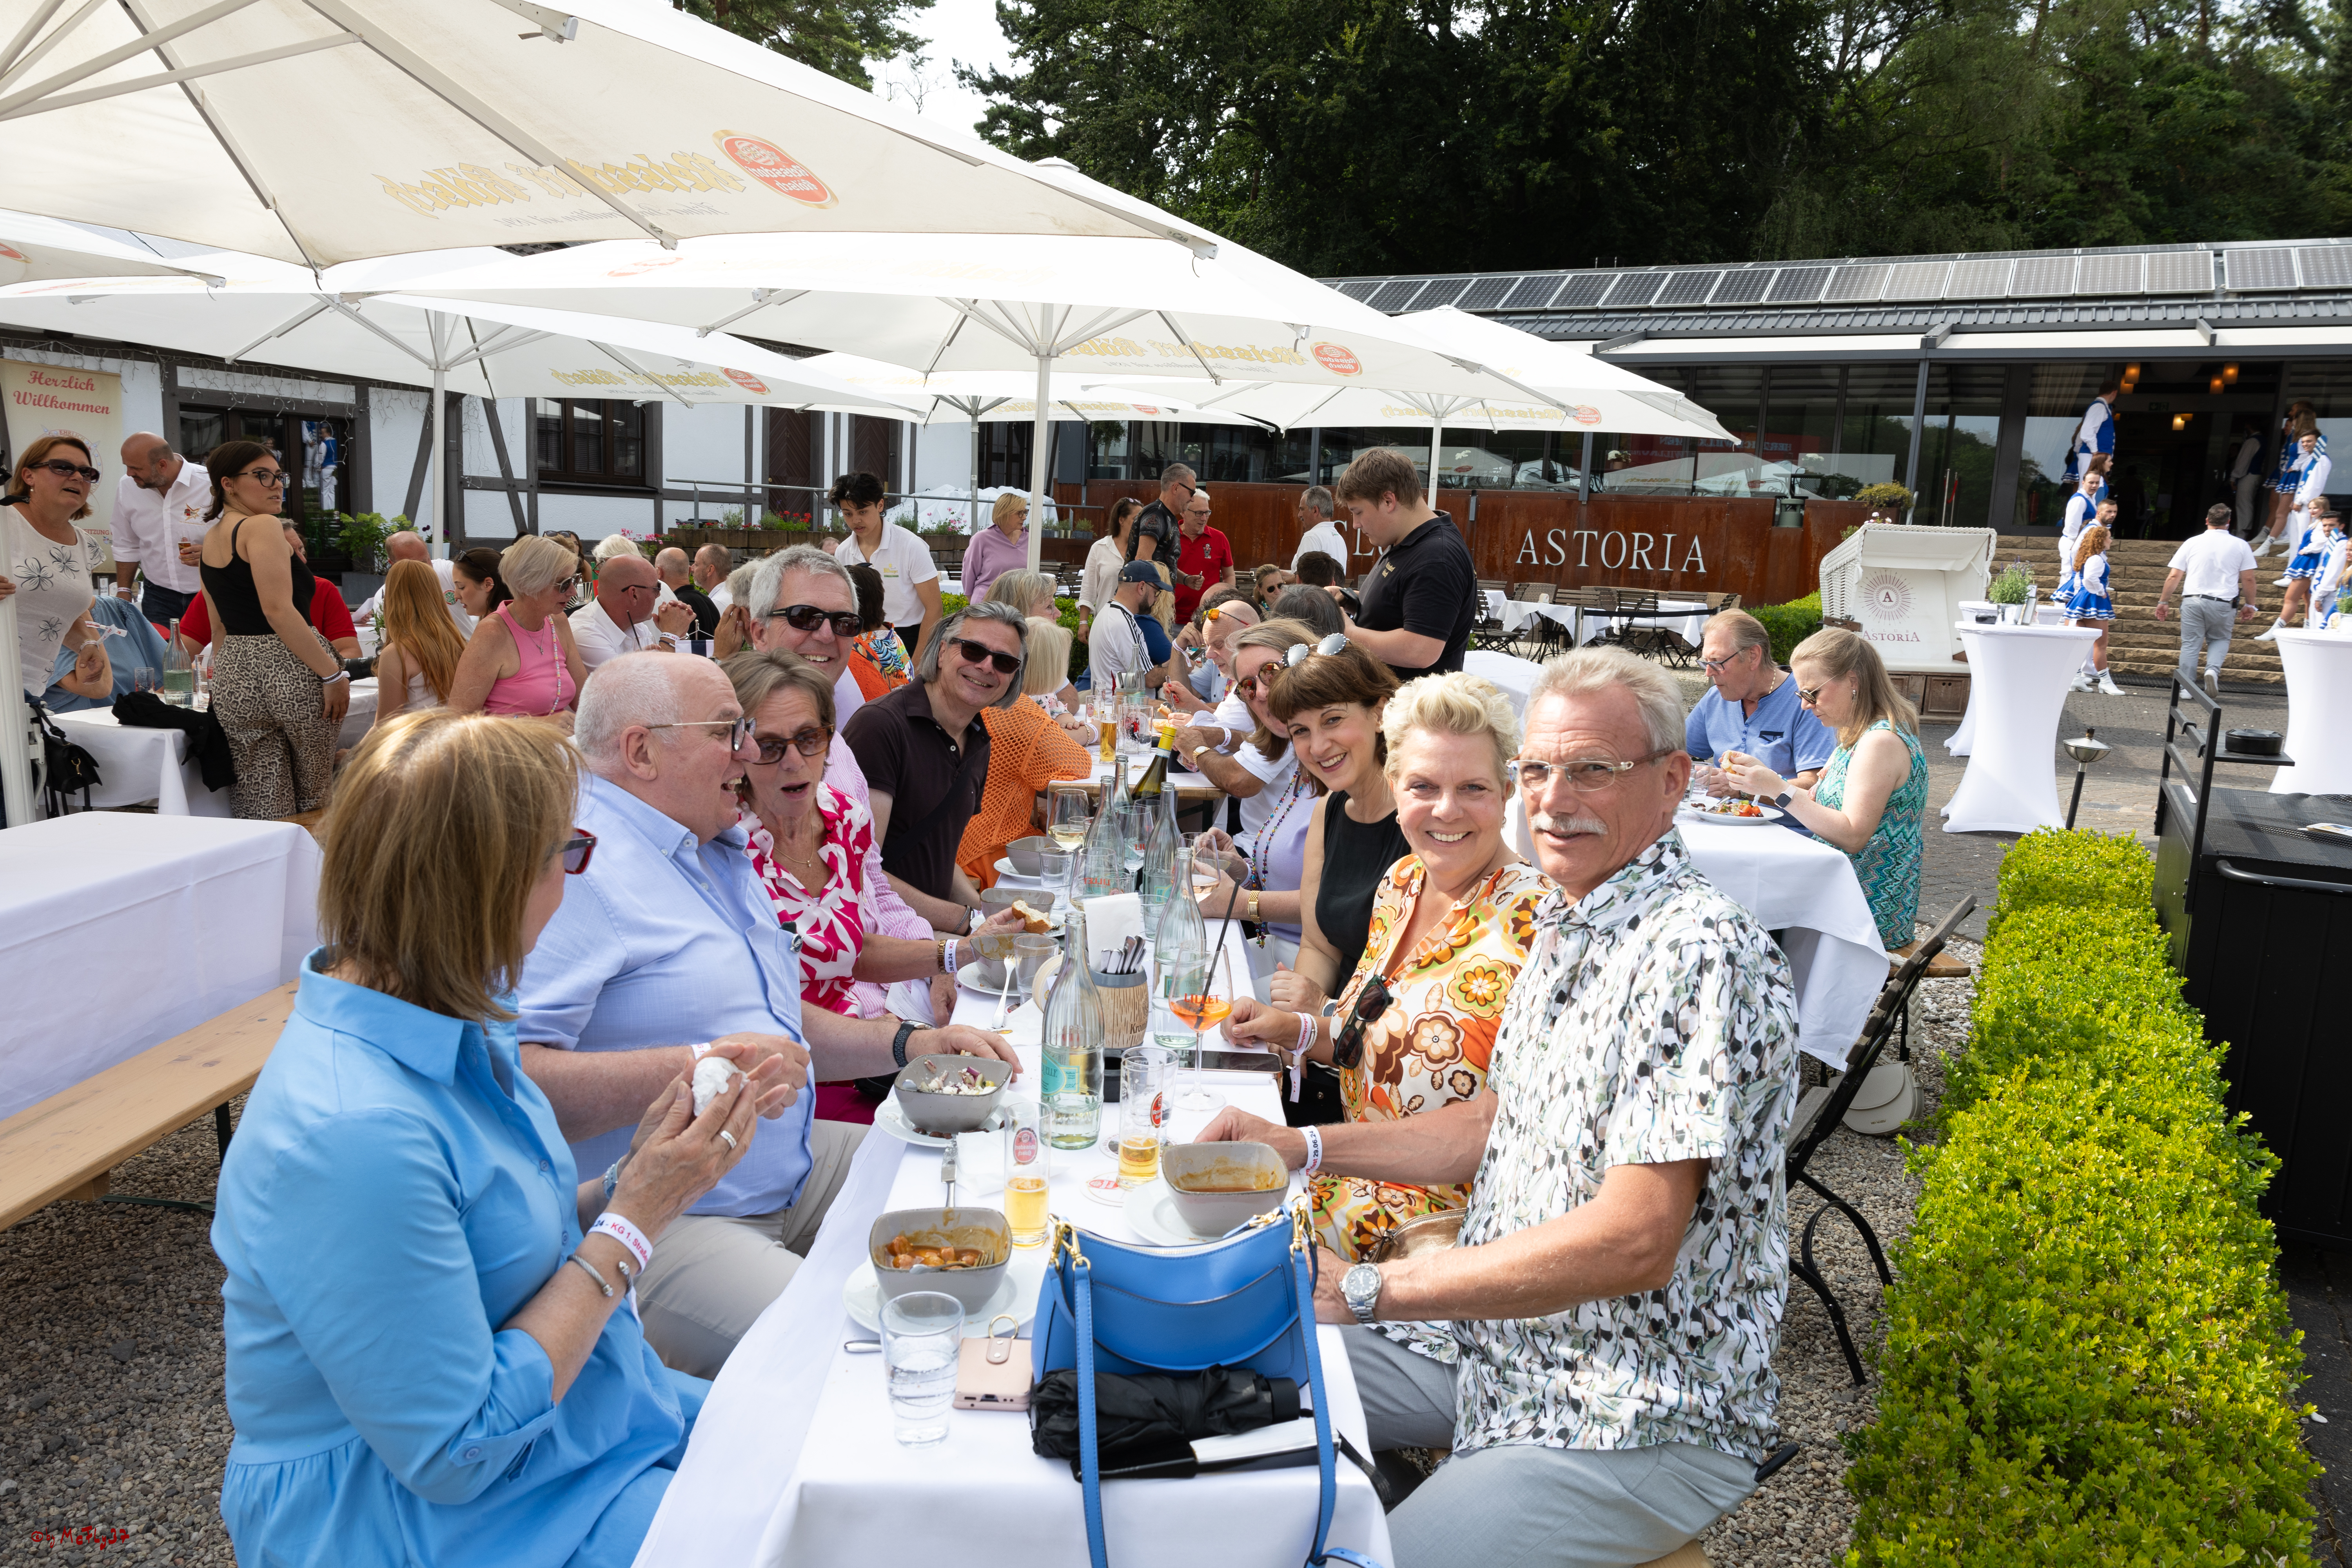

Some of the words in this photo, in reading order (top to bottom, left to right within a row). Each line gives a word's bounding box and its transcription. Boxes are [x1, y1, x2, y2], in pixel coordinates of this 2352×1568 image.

[27, 370, 95, 391] Herzlich
[13, 390, 110, 415] Willkommen
[1515, 528, 1707, 573] ASTORIA
[1882, 591, 1893, 602] A
[1863, 630, 1921, 642] ASTORIA
[1183, 993, 1220, 1004] LILLET
[1308, 1131, 1318, 1157] 29.06.24
[610, 1222, 624, 1234] KG
[626, 1232, 631, 1241] 1.
